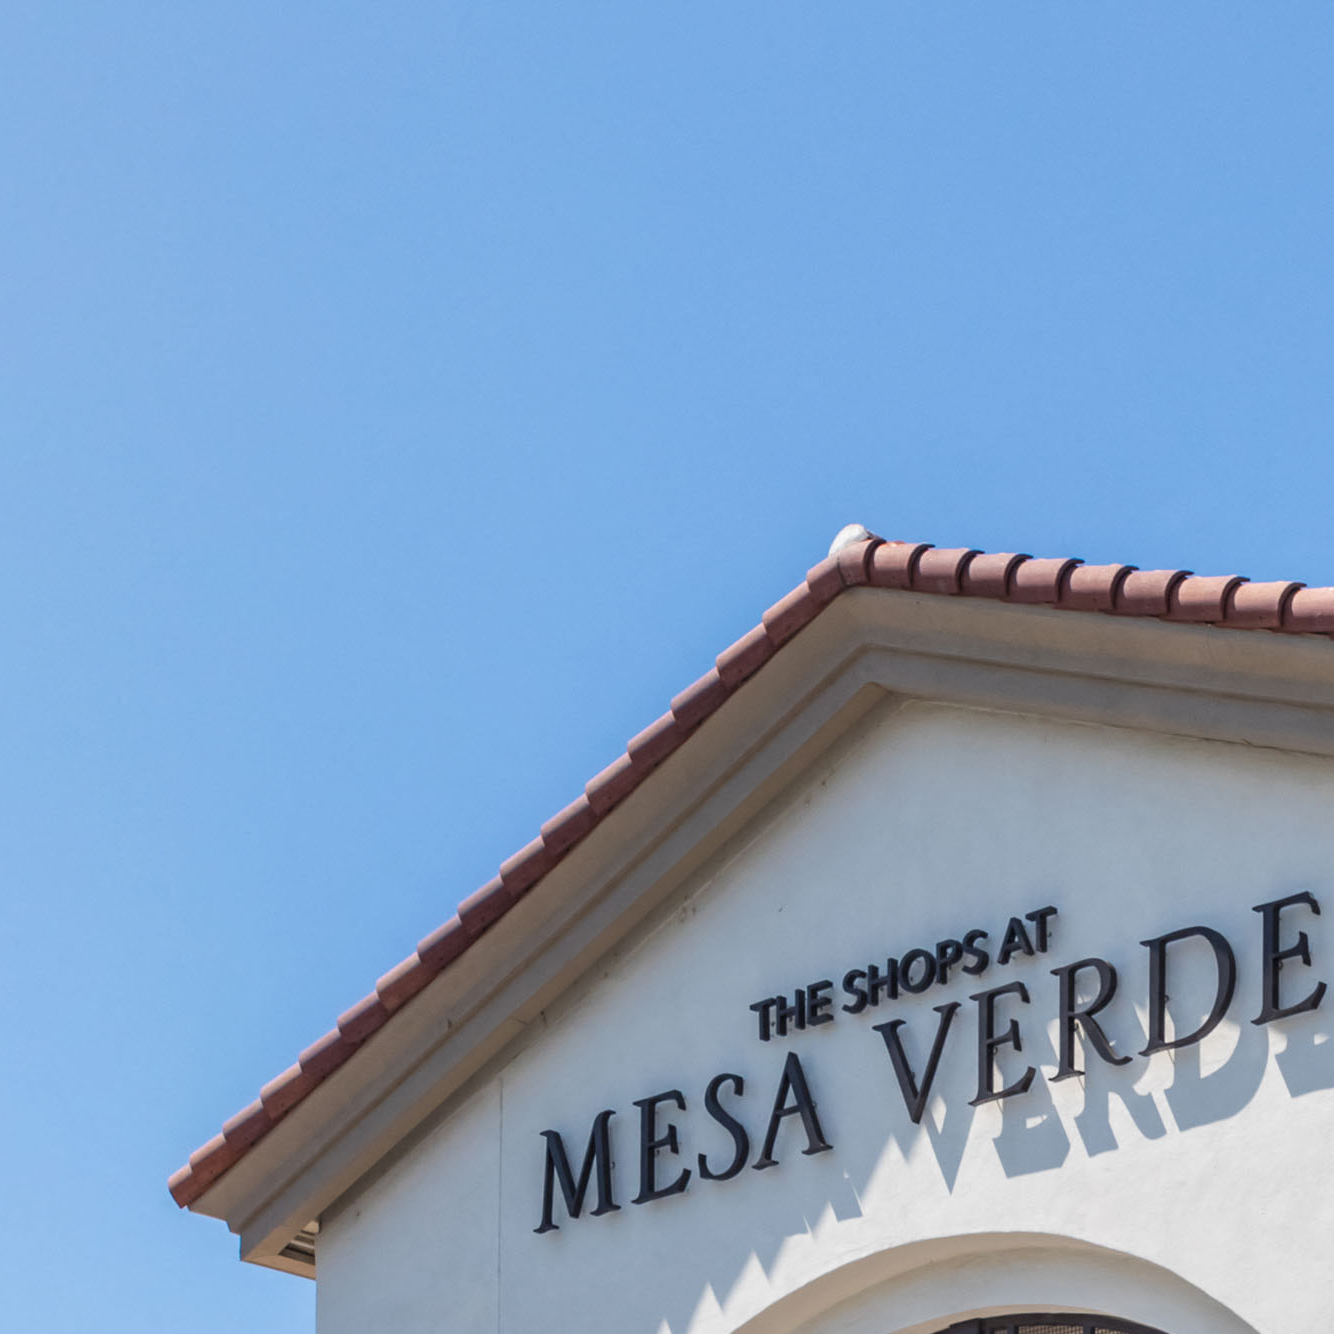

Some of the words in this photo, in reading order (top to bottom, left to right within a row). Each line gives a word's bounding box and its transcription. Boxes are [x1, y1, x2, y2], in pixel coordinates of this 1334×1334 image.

[532, 1051, 834, 1234] MESA
[871, 890, 1329, 1126] VERDE
[749, 979, 835, 1042] THE
[842, 929, 990, 1014] SHOPS
[997, 905, 1058, 965] AT
